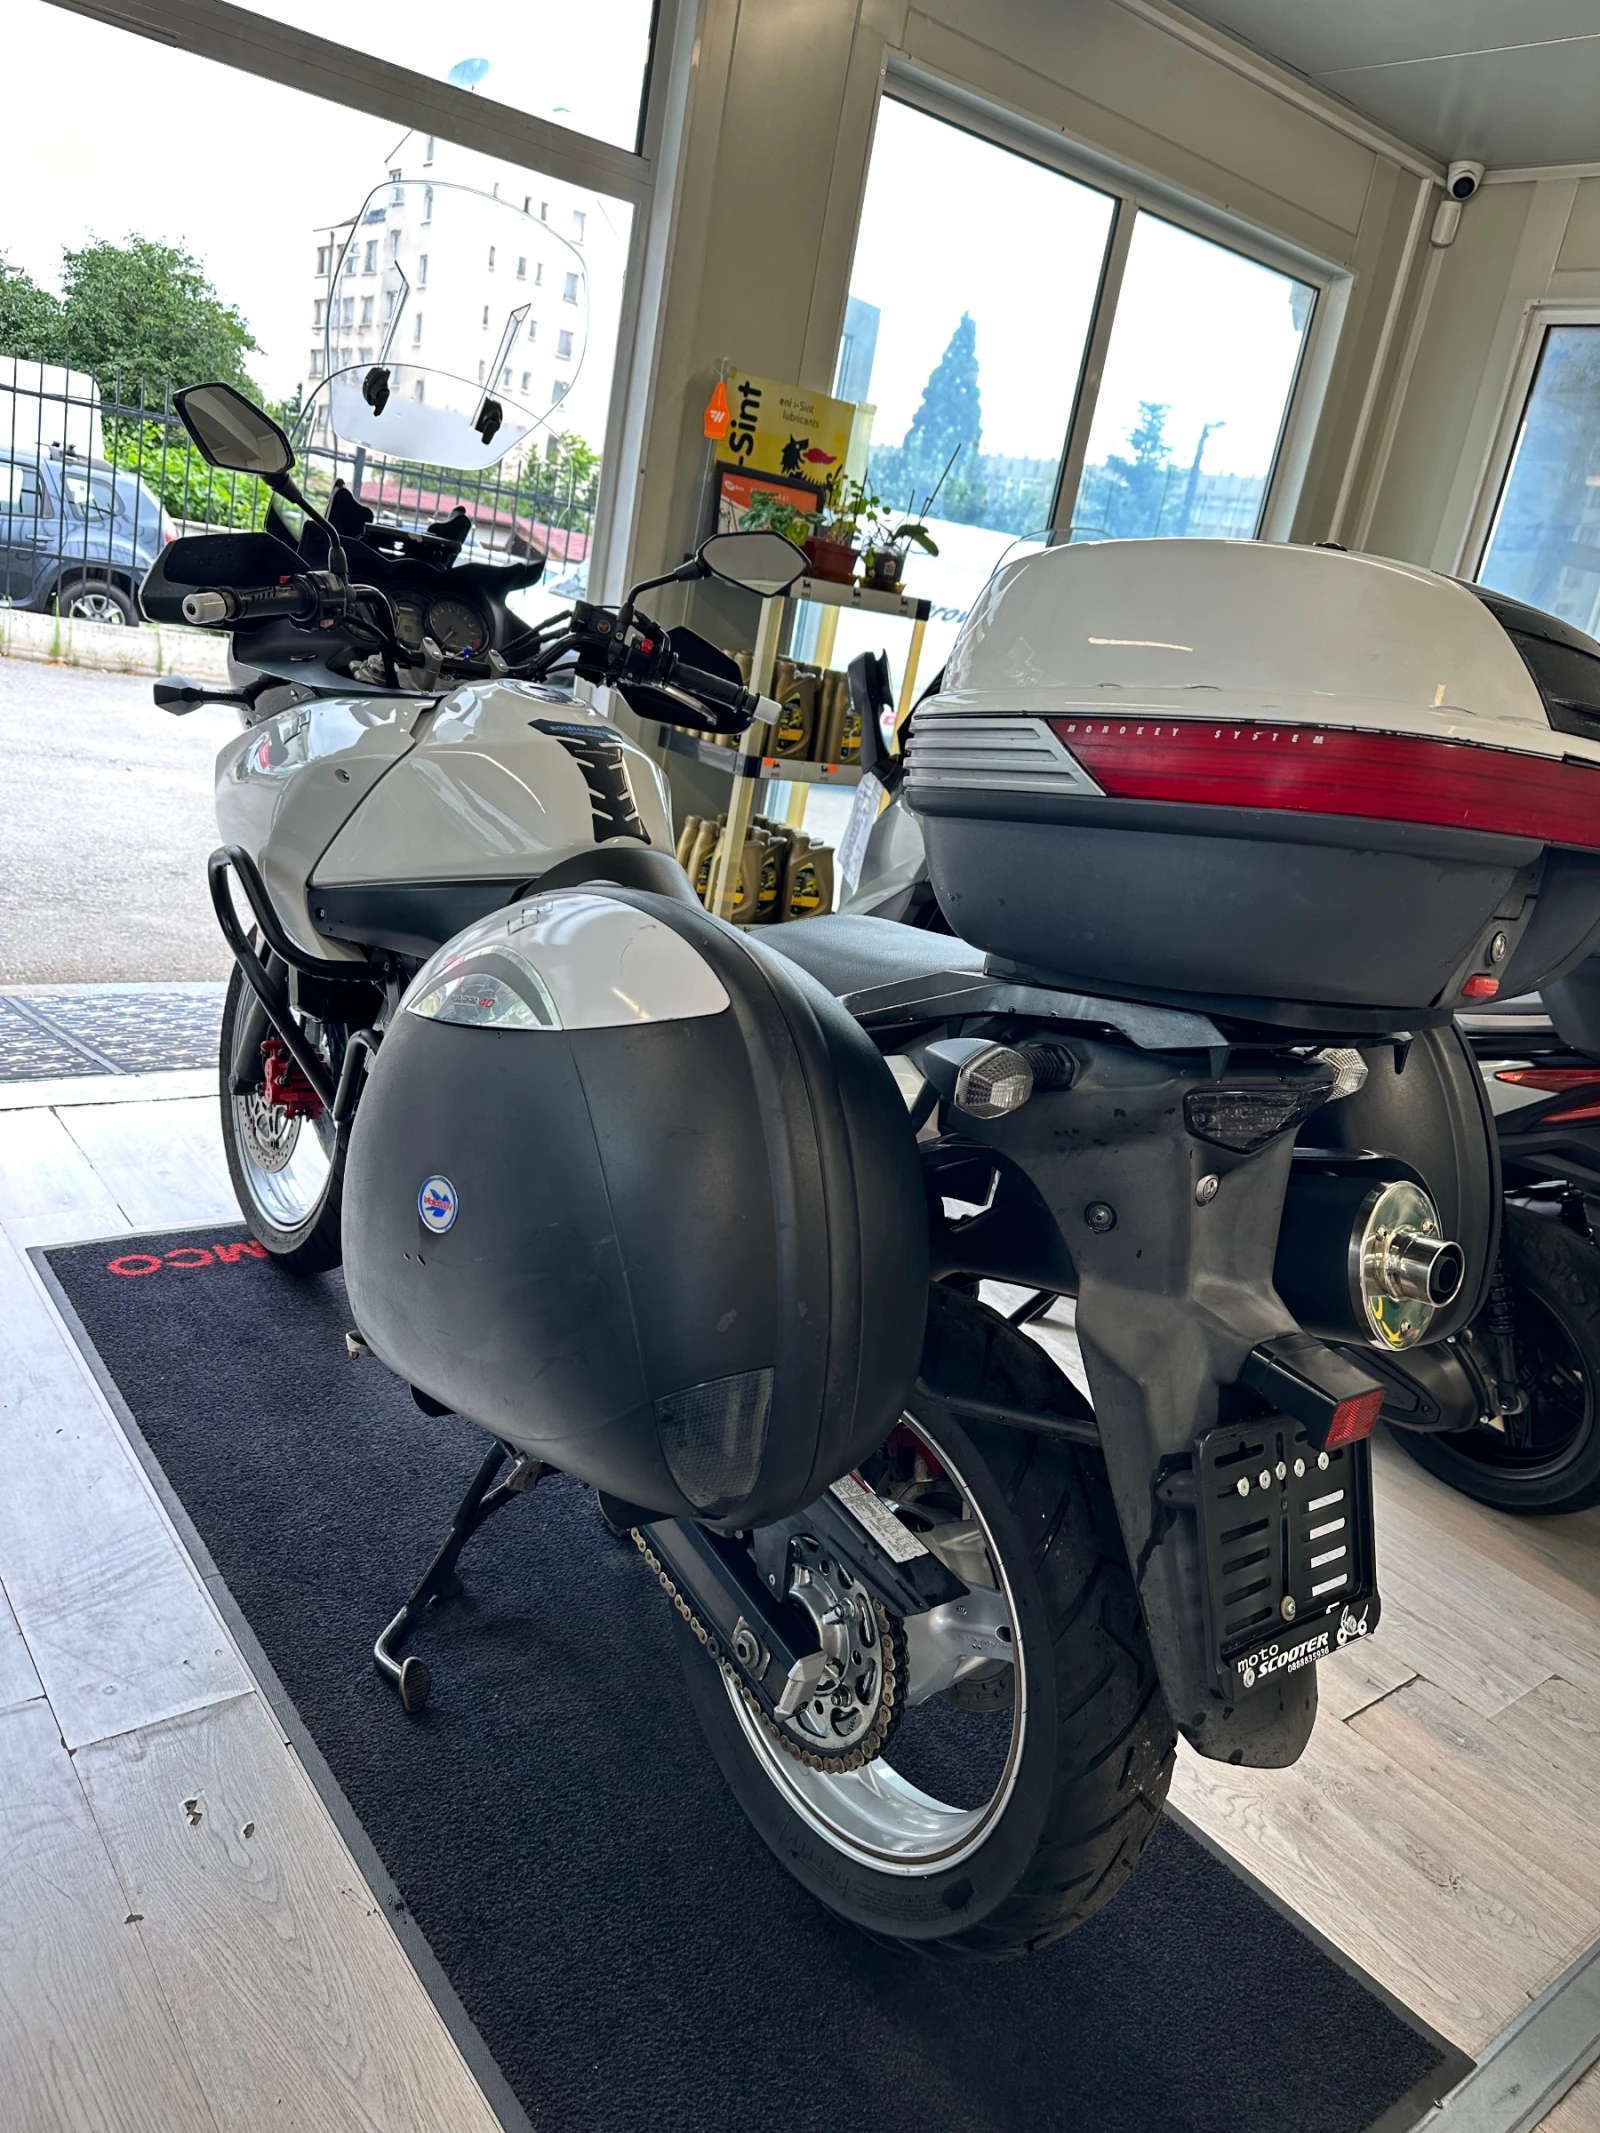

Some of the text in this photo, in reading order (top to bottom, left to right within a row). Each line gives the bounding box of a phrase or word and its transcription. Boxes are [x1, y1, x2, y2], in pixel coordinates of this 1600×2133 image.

[779, 397, 792, 408] eni
[729, 381, 762, 466] -Sint
[782, 409, 819, 429] lubricants
[1067, 724, 1324, 745] MONOKEY SYSTEM
[478, 997, 496, 1008] 40
[107, 1239, 269, 1276] MCO
[1237, 1644, 1279, 1673] moto
[1258, 1632, 1329, 1678] SCOOTER
